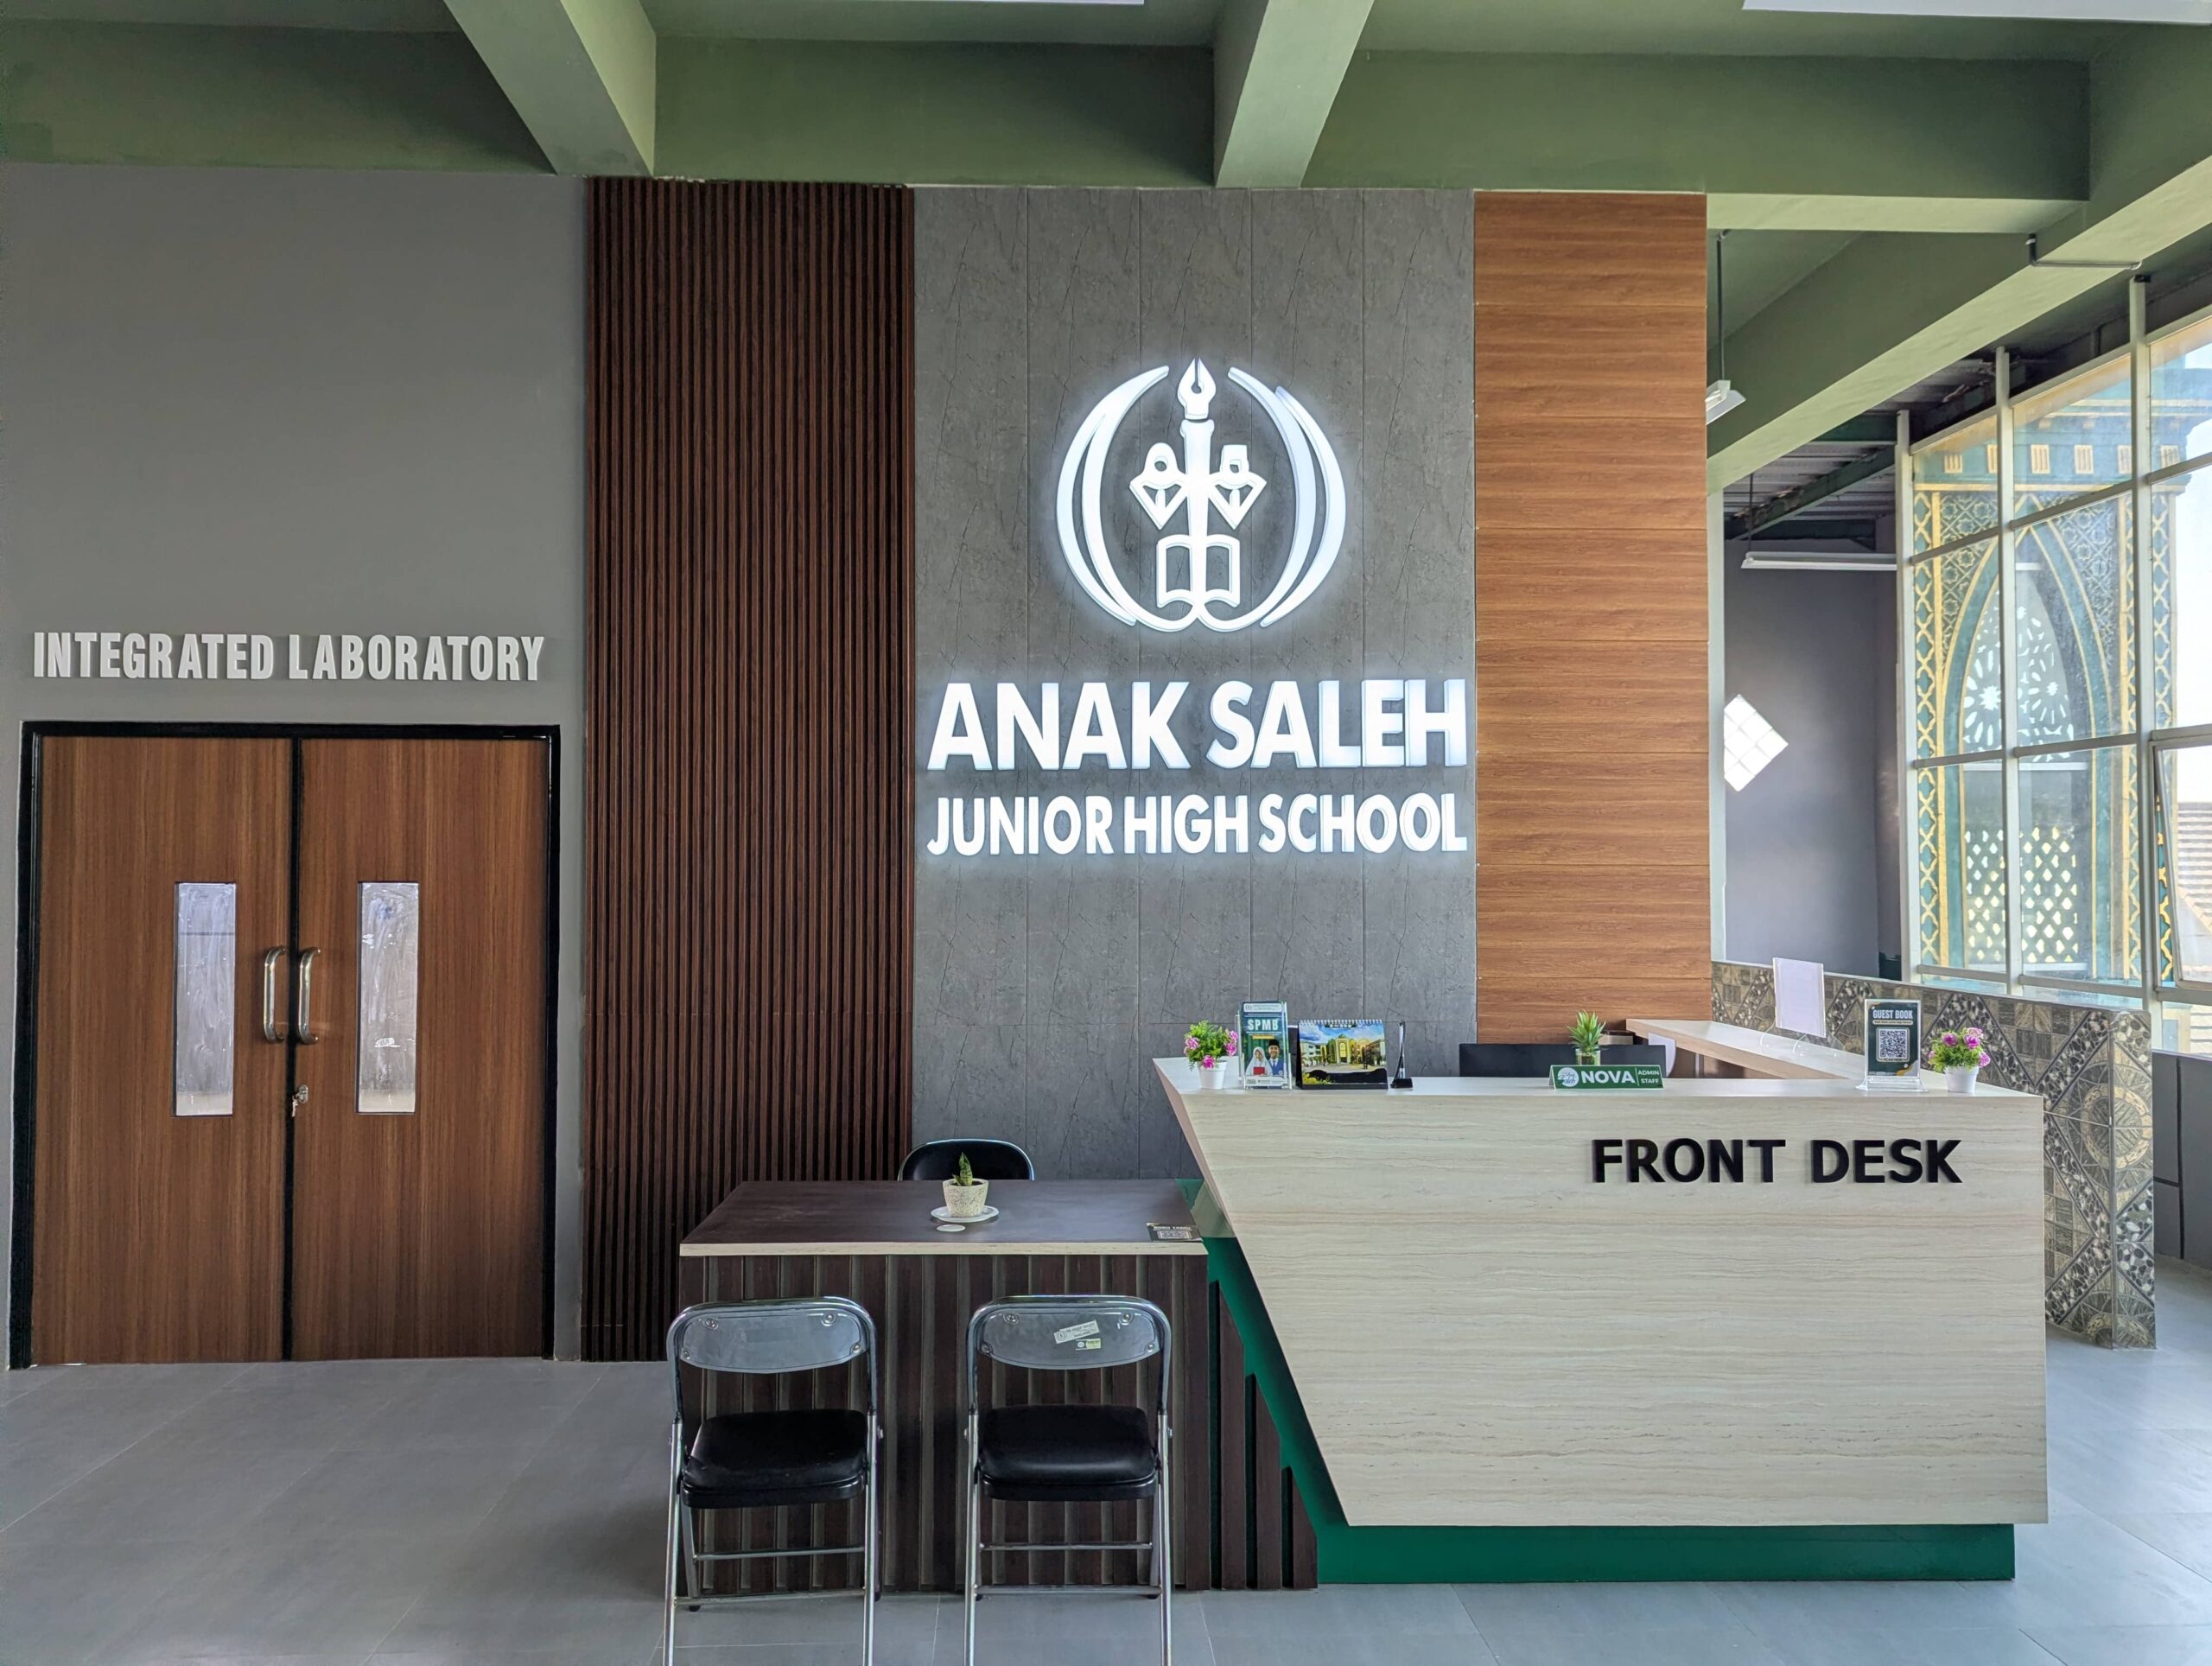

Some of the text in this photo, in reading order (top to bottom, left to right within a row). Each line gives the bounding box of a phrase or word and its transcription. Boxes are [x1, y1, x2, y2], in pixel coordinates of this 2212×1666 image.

[34, 632, 545, 681] INTEGRATED LABORATORY
[926, 678, 1468, 771] ANAK SALEH
[926, 792, 1468, 855] JUNIOR HIGH SCHOOL
[1247, 1019, 1279, 1031] SPMB
[1872, 1009, 1913, 1020] GUEST BOOK
[1580, 1070, 1636, 1084] NOVA
[1591, 1137, 1963, 1184] FRONT DESK
